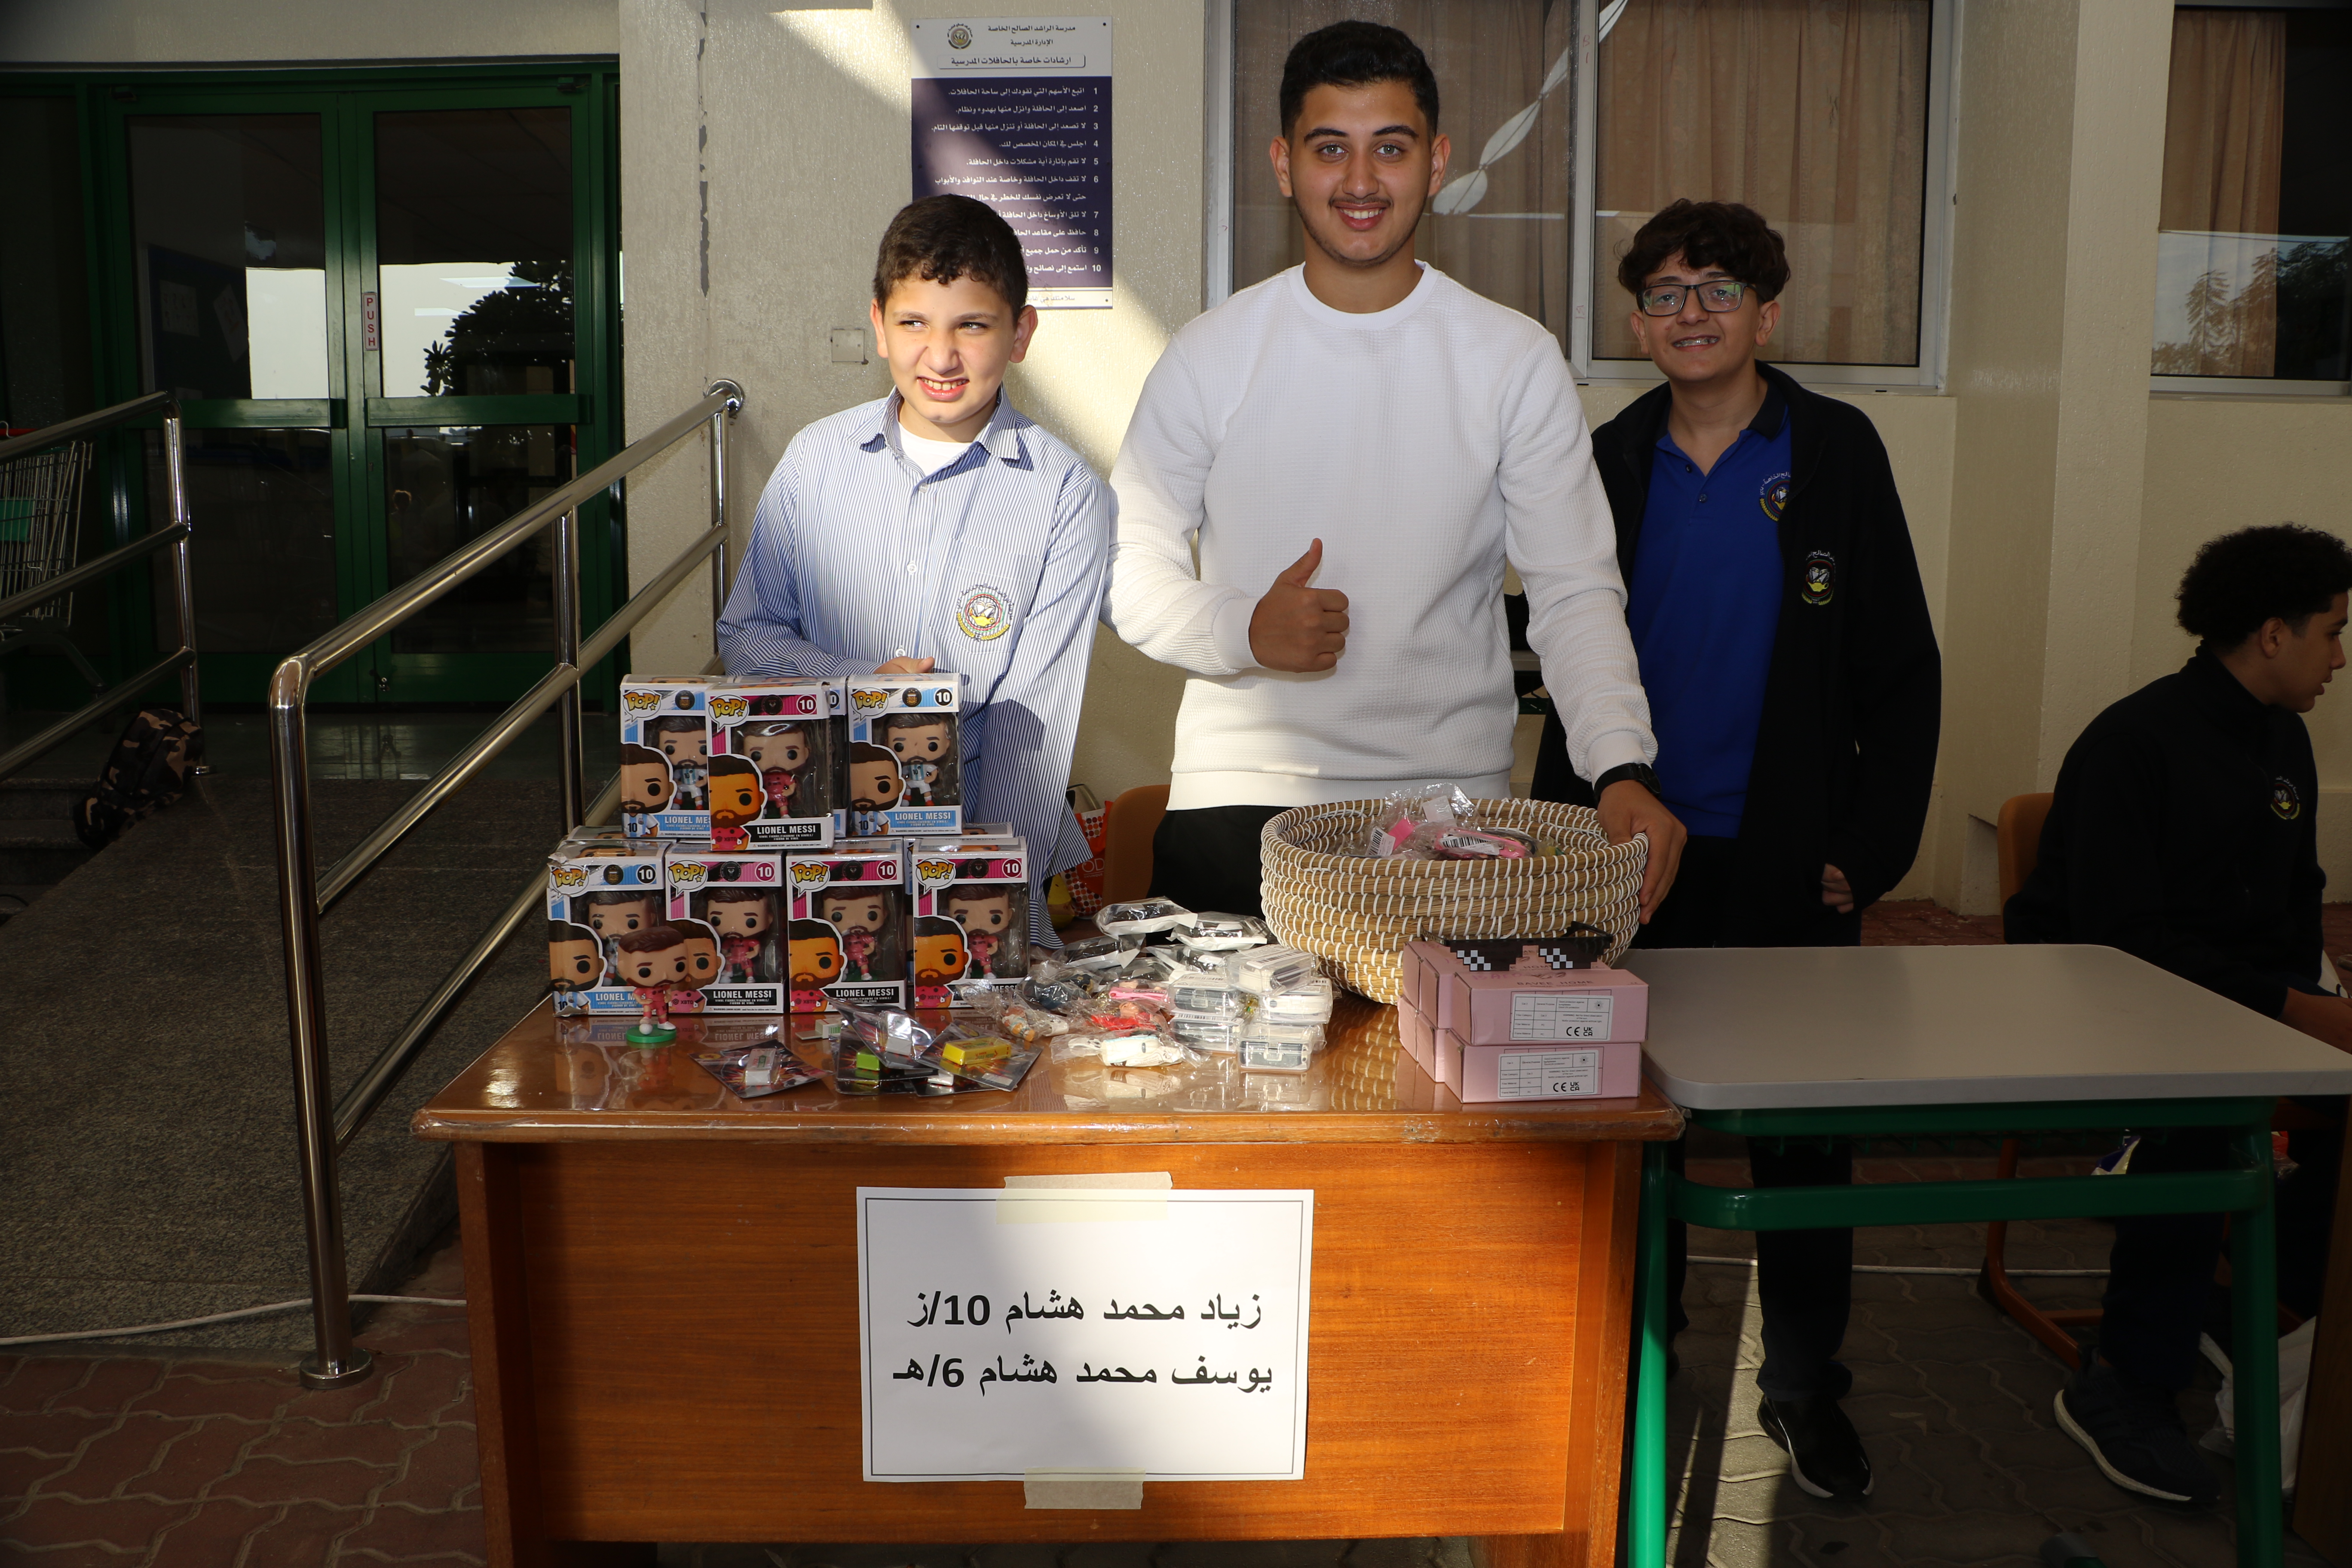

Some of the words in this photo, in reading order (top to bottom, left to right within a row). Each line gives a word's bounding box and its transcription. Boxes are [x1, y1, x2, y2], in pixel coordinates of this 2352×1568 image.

[1011, 25, 1033, 33] الصالح
[951, 58, 980, 66] المدرسية
[1011, 88, 1032, 96] تقودك
[1033, 88, 1047, 97] التي
[1048, 86, 1070, 95] الأسهم
[1072, 87, 1084, 96] اتبع
[956, 106, 976, 114] ونظام.
[998, 105, 1011, 113] منها
[1013, 105, 1031, 113] وانزل
[1057, 105, 1067, 113] إلى
[931, 124, 948, 132] التام.
[949, 123, 970, 132] توقفها
[971, 123, 983, 132] قبل
[1000, 123, 1015, 131] تنزل
[1017, 121, 1023, 132] أو
[1012, 141, 1041, 149] المخصص
[1038, 156, 1047, 166] أية
[1048, 157, 1066, 166] بإثارة
[1068, 158, 1079, 166] تقم
[934, 175, 961, 185] والأبواب
[962, 176, 984, 184] النوافذ
[999, 175, 1022, 184] وخاصة
[990, 193, 998, 202] في
[998, 193, 1021, 202] للخطر
[1044, 209, 1068, 221] الأوساخ
[1068, 211, 1079, 219] تلق
[1053, 229, 1066, 237] على
[1025, 248, 1043, 257] جميع
[1044, 247, 1060, 255] حمل
[1061, 247, 1072, 255] من
[1073, 245, 1087, 253] تأكد
[1033, 264, 1055, 274] نصائح
[1056, 264, 1066, 273] إلى
[1067, 264, 1087, 274] استمع
[366, 297, 376, 346] PUSH
[937, 692, 950, 703] 10
[799, 700, 814, 710] 10
[895, 812, 923, 821] LIONEL
[925, 812, 951, 820] MESSI
[627, 822, 637, 833] 10
[859, 820, 869, 830] 10
[756, 826, 787, 835] LIONEL
[789, 825, 816, 834] MESSI
[758, 867, 772, 878] 10
[880, 865, 894, 876] 10
[1005, 863, 1019, 873] 10
[639, 869, 653, 880] 10
[713, 990, 743, 998] LIONEL
[745, 990, 772, 998] MESSI
[867, 988, 894, 996] MESSI
[595, 993, 625, 1001] LIONEL
[1566, 1026, 1580, 1037] CE
[1553, 1082, 1567, 1092] CE
[907, 1291, 990, 1327] 10/ز
[1006, 1290, 1084, 1334] هشام
[1104, 1300, 1184, 1320] محمد
[1201, 1294, 1260, 1329] زياد
[980, 1354, 1057, 1396] هشام
[1077, 1363, 1156, 1383] محمد
[1172, 1356, 1271, 1393] يوسف
